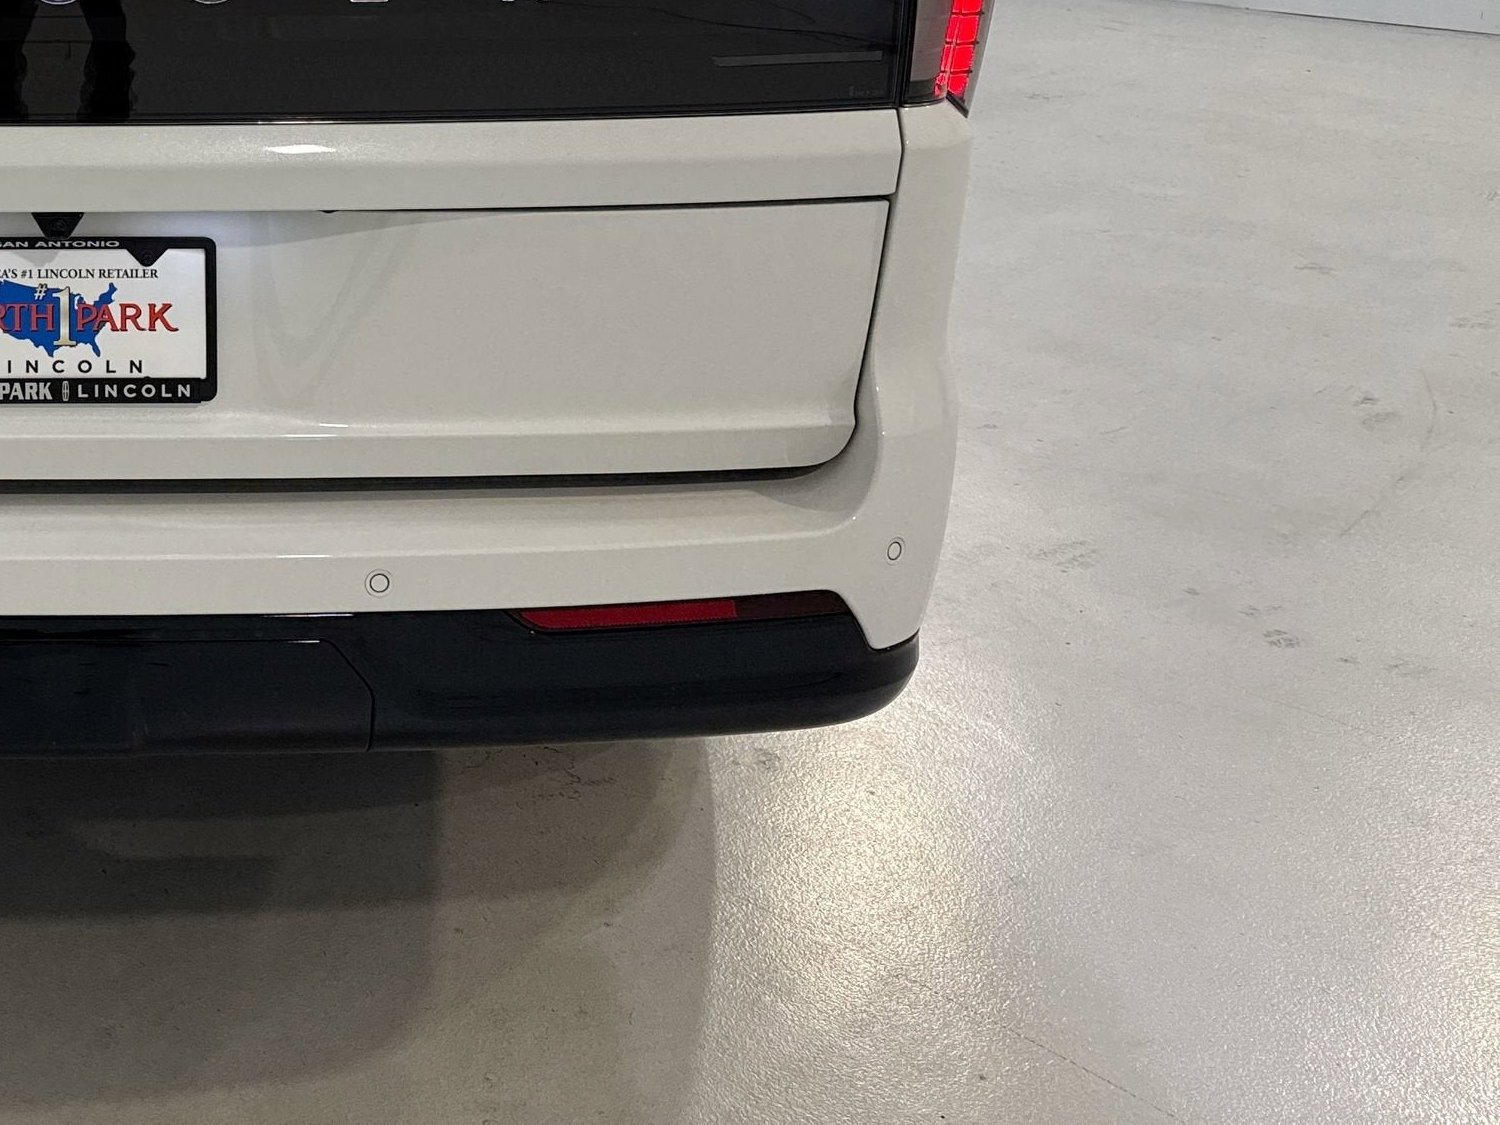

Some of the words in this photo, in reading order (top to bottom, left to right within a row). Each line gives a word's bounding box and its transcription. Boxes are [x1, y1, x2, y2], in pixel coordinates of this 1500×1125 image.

[35, 240, 120, 248] ANTONIO
[21, 268, 33, 279] #1
[38, 268, 95, 279] LINCOLN
[98, 268, 159, 279] RETAILER
[76, 302, 179, 332] PARK
[77, 383, 191, 399] LINCOLN
